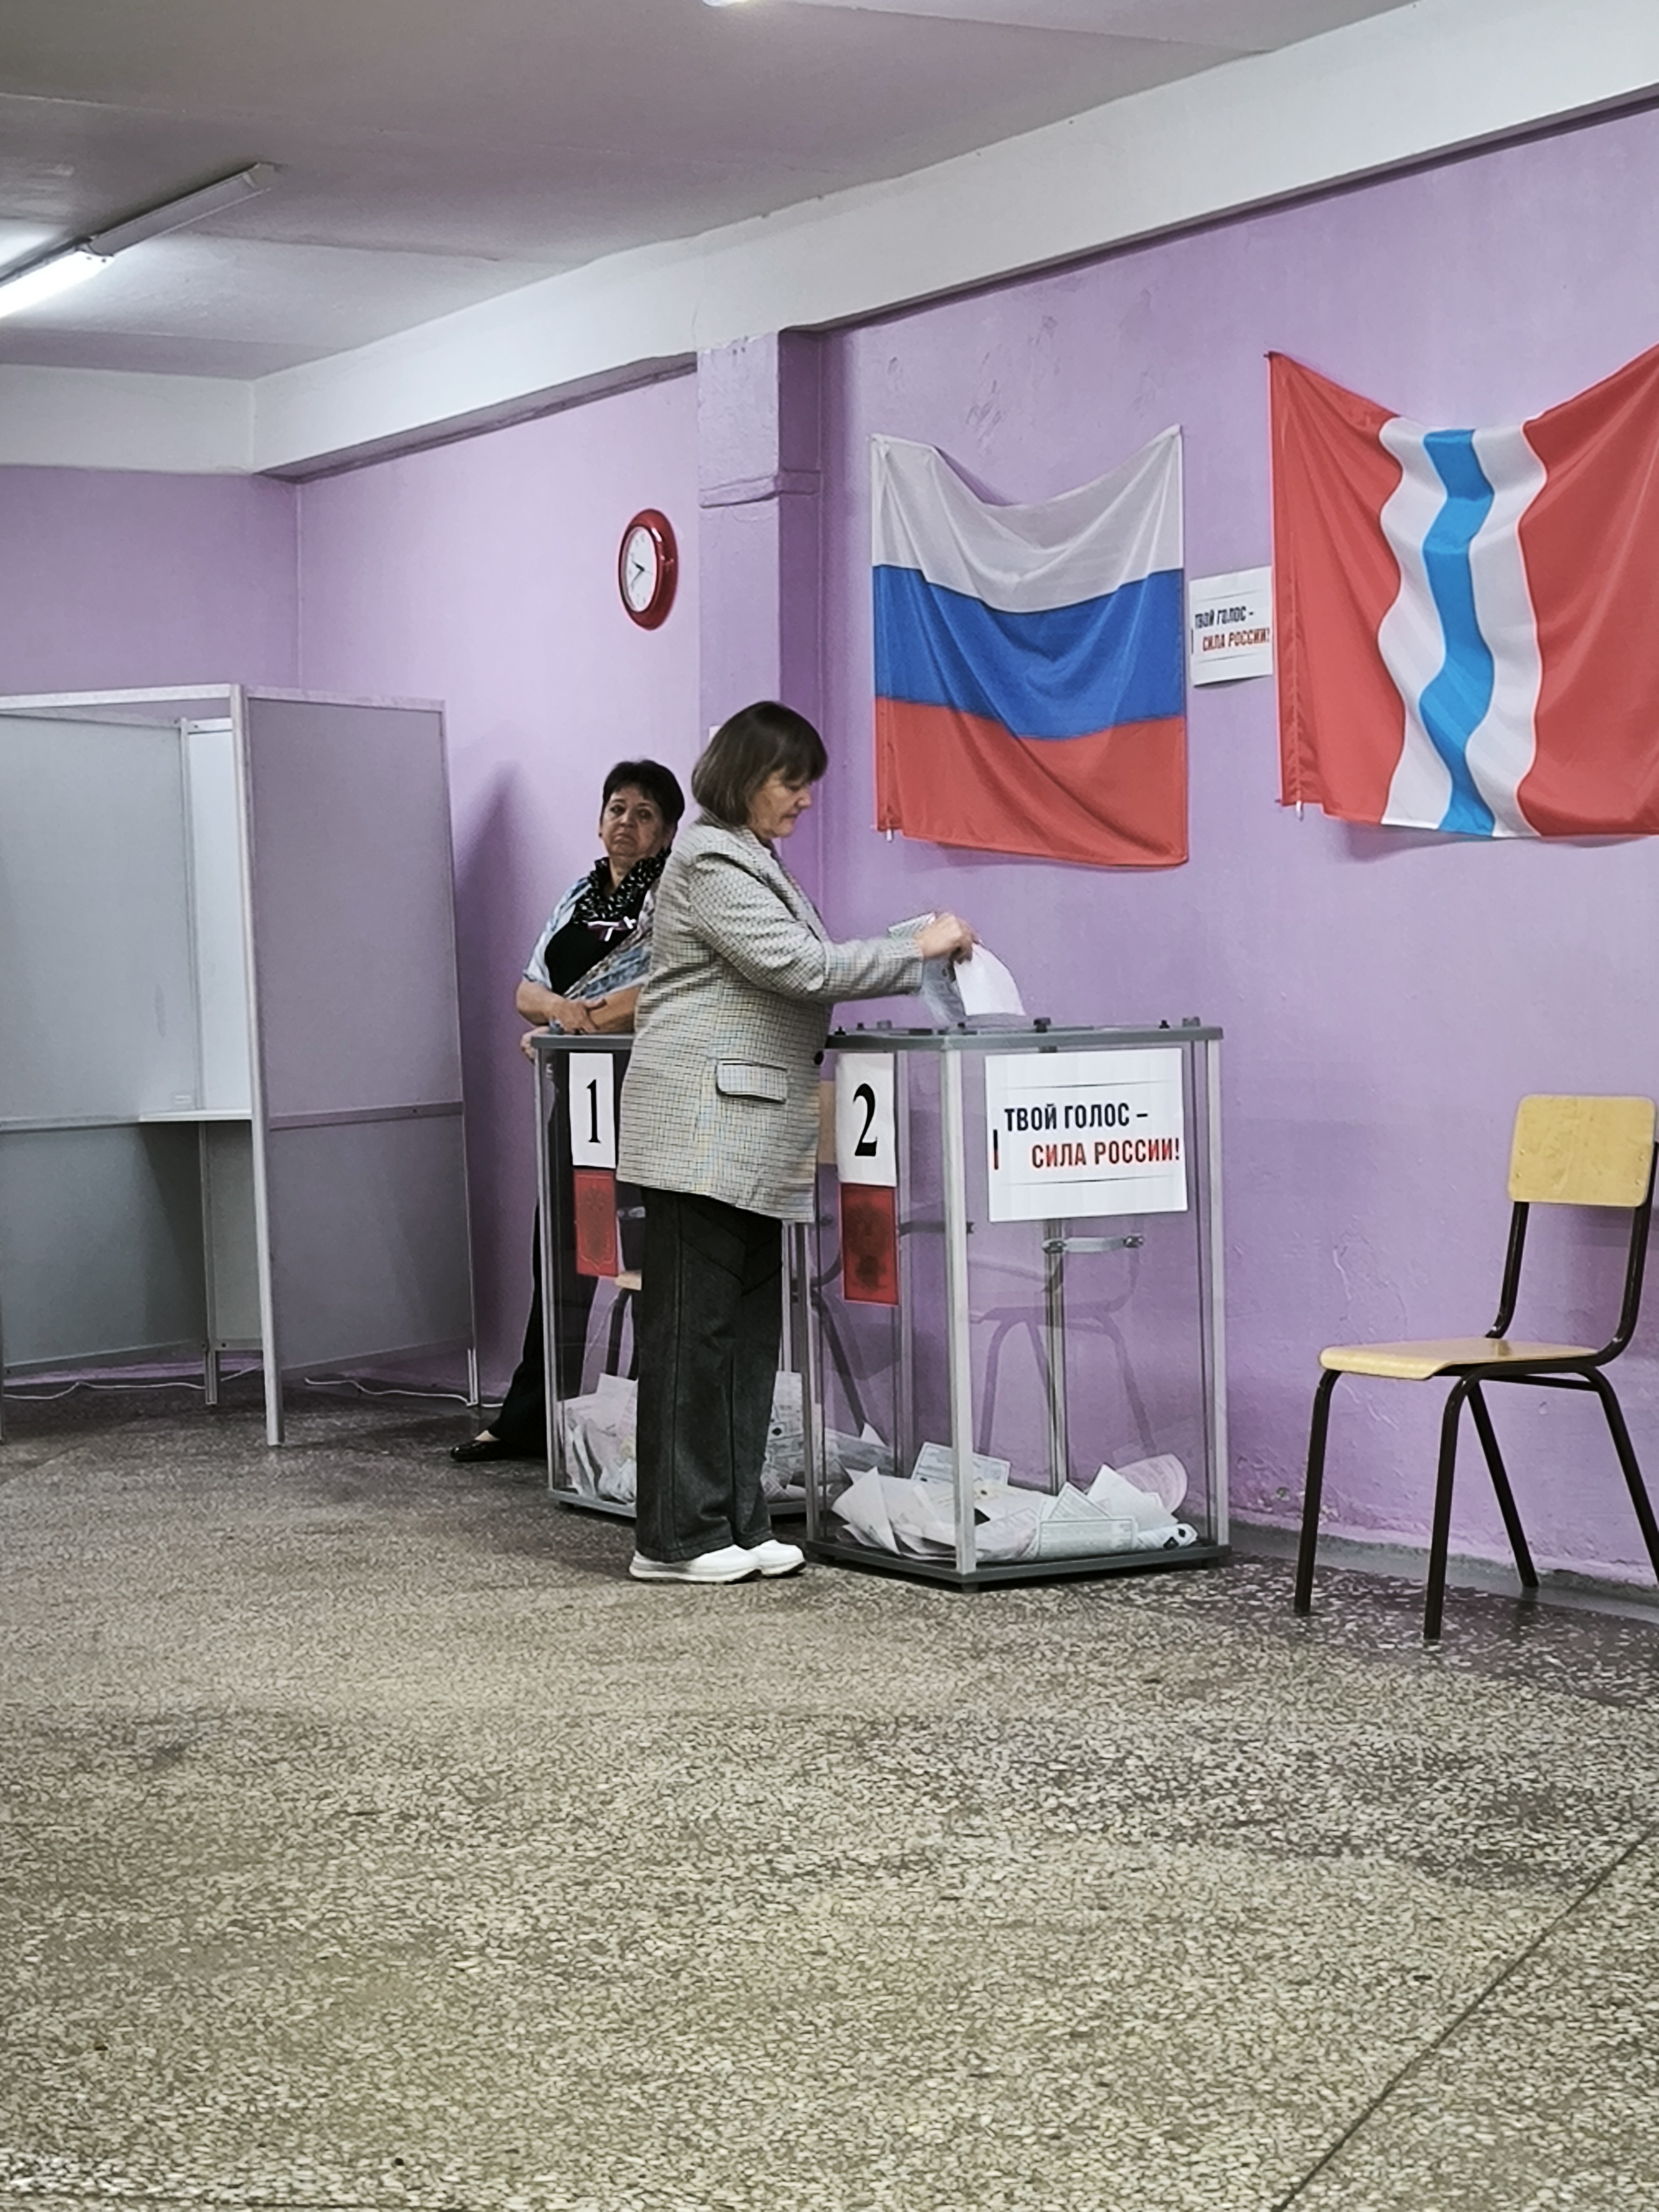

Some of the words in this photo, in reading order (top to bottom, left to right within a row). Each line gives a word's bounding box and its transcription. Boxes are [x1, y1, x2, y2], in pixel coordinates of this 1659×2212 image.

[1195, 609, 1214, 629] ТВОЙ
[1217, 606, 1246, 625] ГОЛОС
[1203, 633, 1225, 651] СИЛА
[586, 1078, 601, 1143] 1
[852, 1082, 878, 1157] 2
[1004, 1103, 1057, 1131] ТВОЙ
[1064, 1102, 1130, 1129] ГОЛОС
[1031, 1143, 1087, 1168] СИЛА
[1094, 1137, 1180, 1165] РОССИИ!
